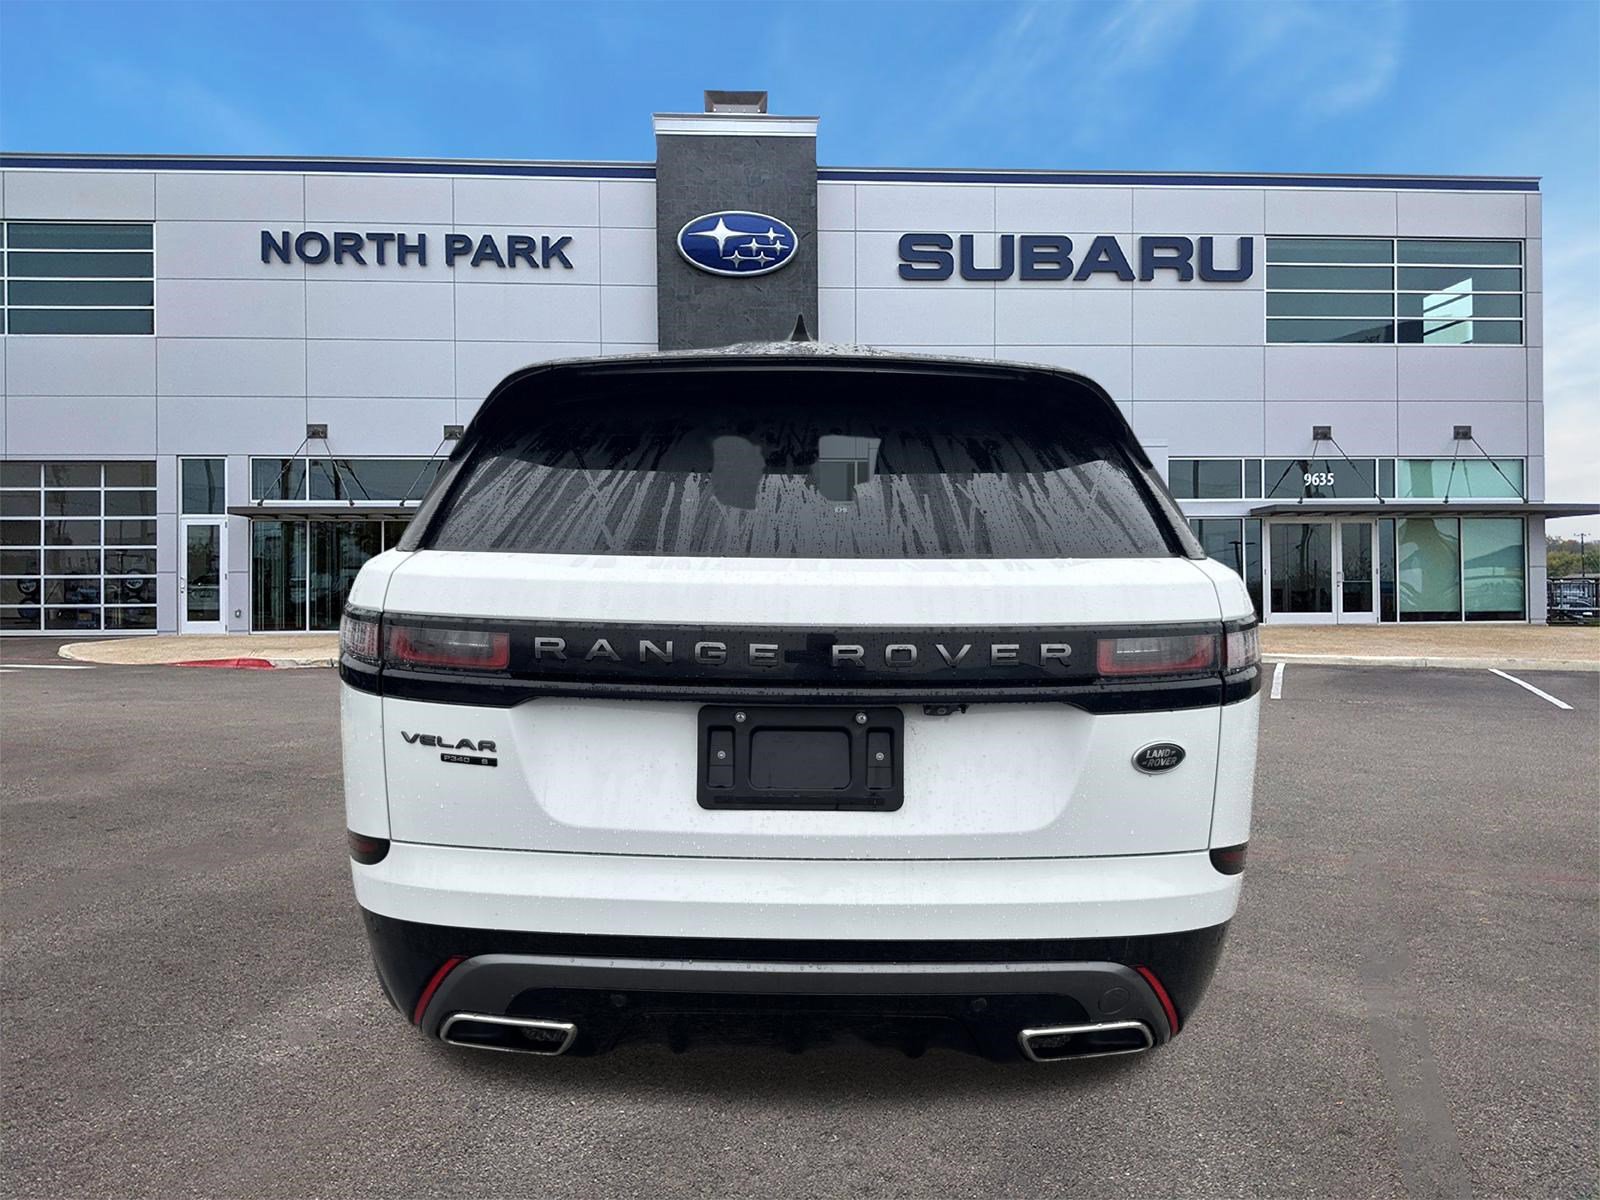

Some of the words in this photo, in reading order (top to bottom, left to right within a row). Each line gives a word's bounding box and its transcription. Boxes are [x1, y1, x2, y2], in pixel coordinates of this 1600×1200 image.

[261, 230, 427, 266] NORTH
[445, 233, 574, 269] PARK
[898, 233, 1254, 282] SUBARU
[1303, 472, 1335, 486] 9635
[534, 636, 779, 667] RANGE
[832, 643, 1073, 667] ROVER
[401, 730, 497, 753] VELAR
[443, 754, 470, 763] P340
[1145, 748, 1171, 759] LAND
[1147, 756, 1178, 767] ROVER
